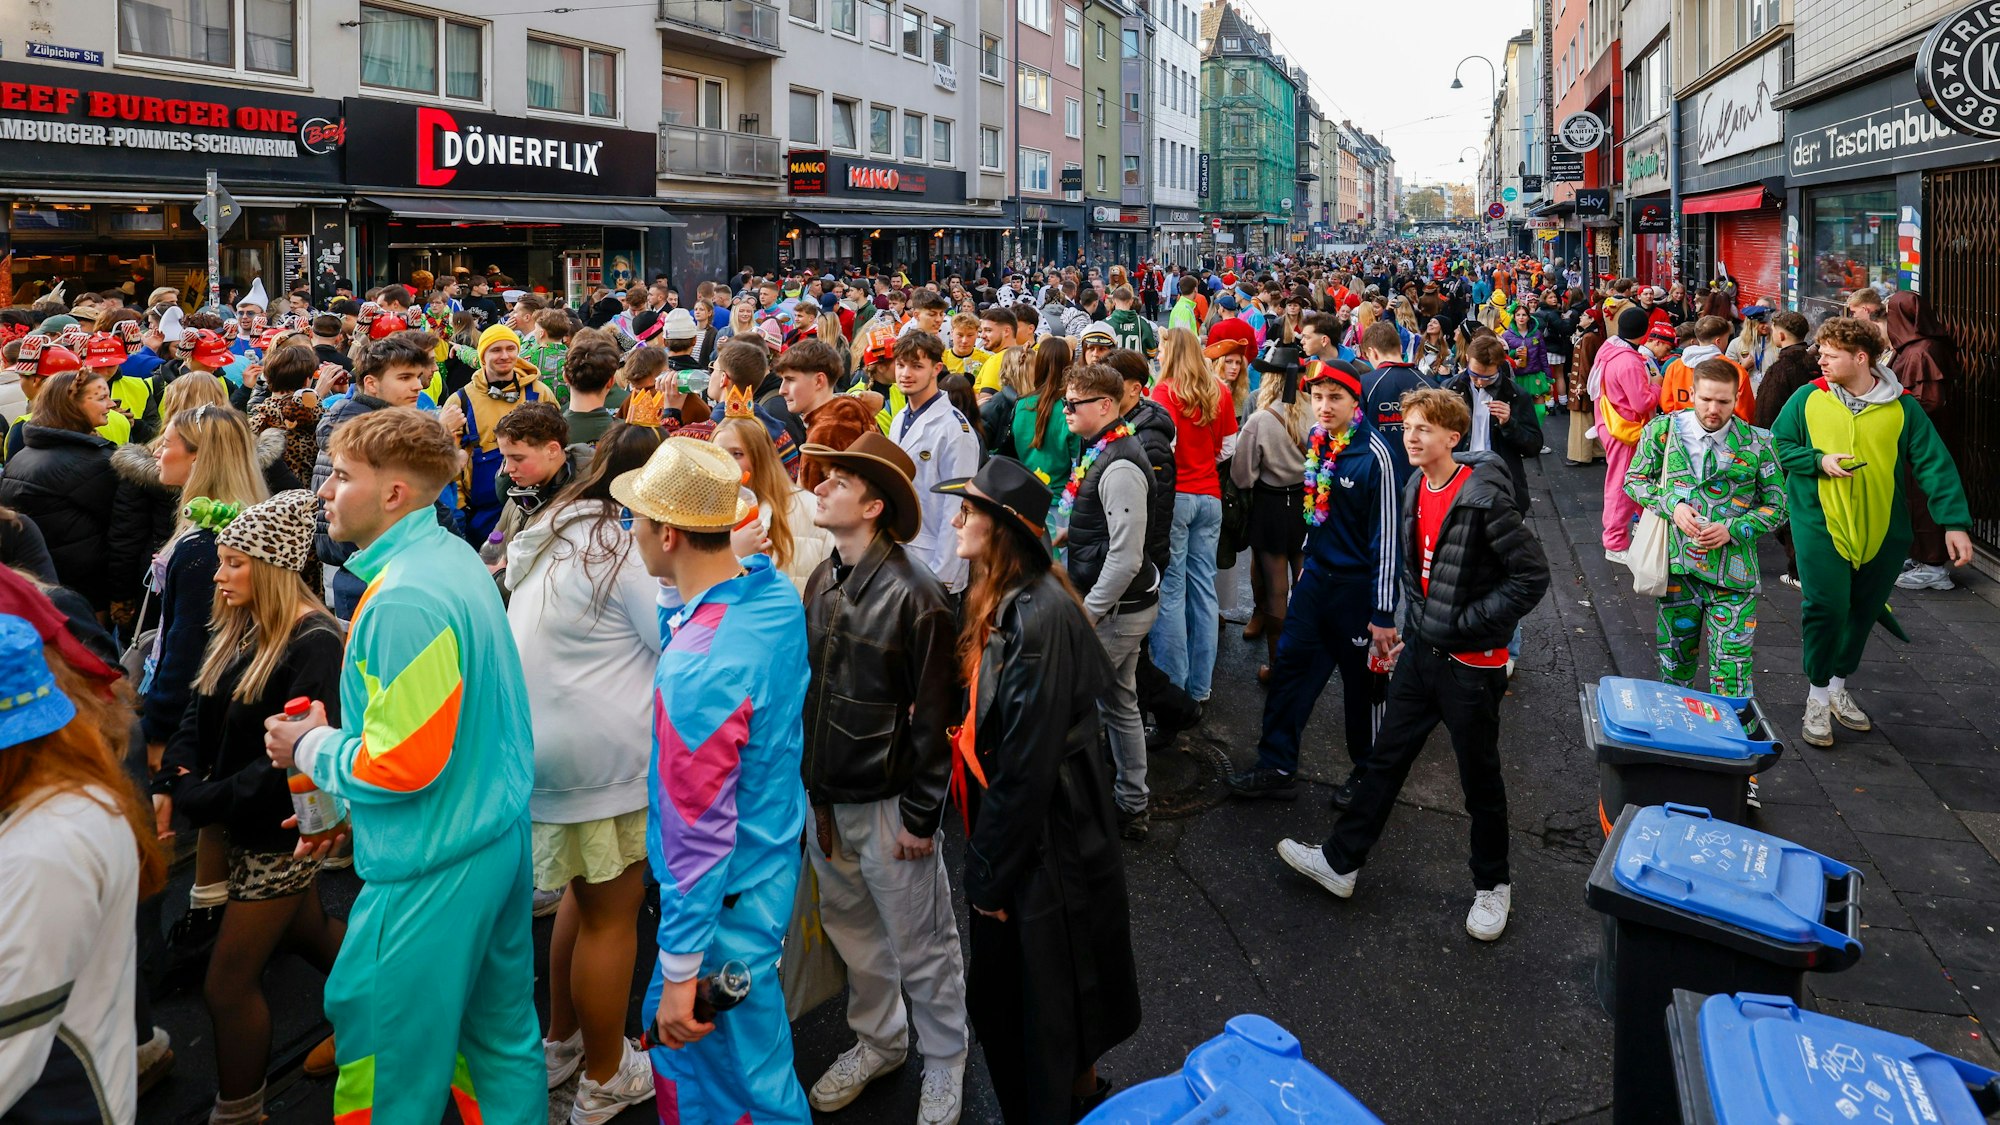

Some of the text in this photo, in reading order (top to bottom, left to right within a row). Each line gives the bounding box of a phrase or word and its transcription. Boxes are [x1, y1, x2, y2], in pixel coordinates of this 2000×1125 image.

[33, 43, 99, 62] Zülpicher Str.
[88, 91, 230, 128] BURGER
[236, 106, 298, 133] ONE
[1825, 107, 1957, 159] Taschenbuc
[442, 125, 600, 177] DÖNERFLIX
[790, 162, 825, 173] MANGO
[848, 165, 900, 191] MANGO
[1579, 194, 1605, 209] sky
[1899, 1060, 1938, 1123] ALTPAPIER
